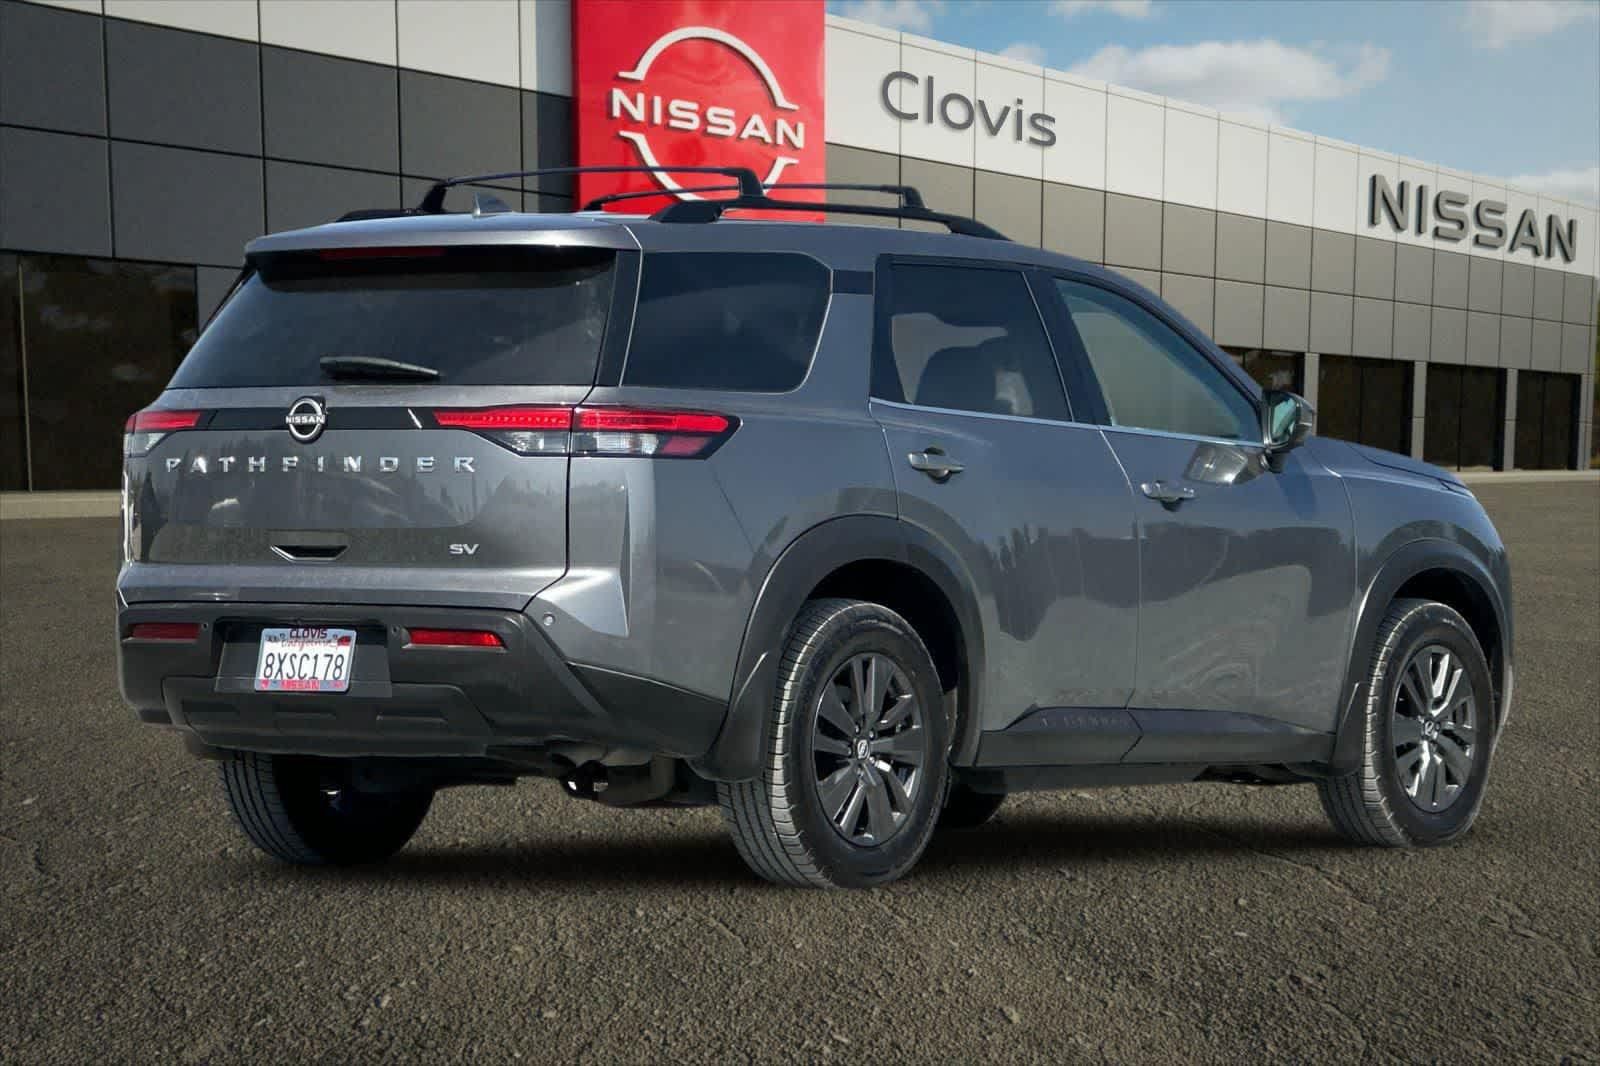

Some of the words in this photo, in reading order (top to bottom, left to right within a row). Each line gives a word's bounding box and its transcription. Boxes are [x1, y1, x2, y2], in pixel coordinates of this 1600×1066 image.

[610, 88, 806, 149] NISSAN
[881, 70, 1057, 147] Clovis
[1369, 173, 1577, 264] NISSAN
[285, 415, 326, 425] NISSAN
[165, 456, 477, 474] PATHFINDER
[449, 543, 480, 555] SV
[289, 628, 328, 639] CLOVIS
[263, 652, 345, 681] 8XSC178
